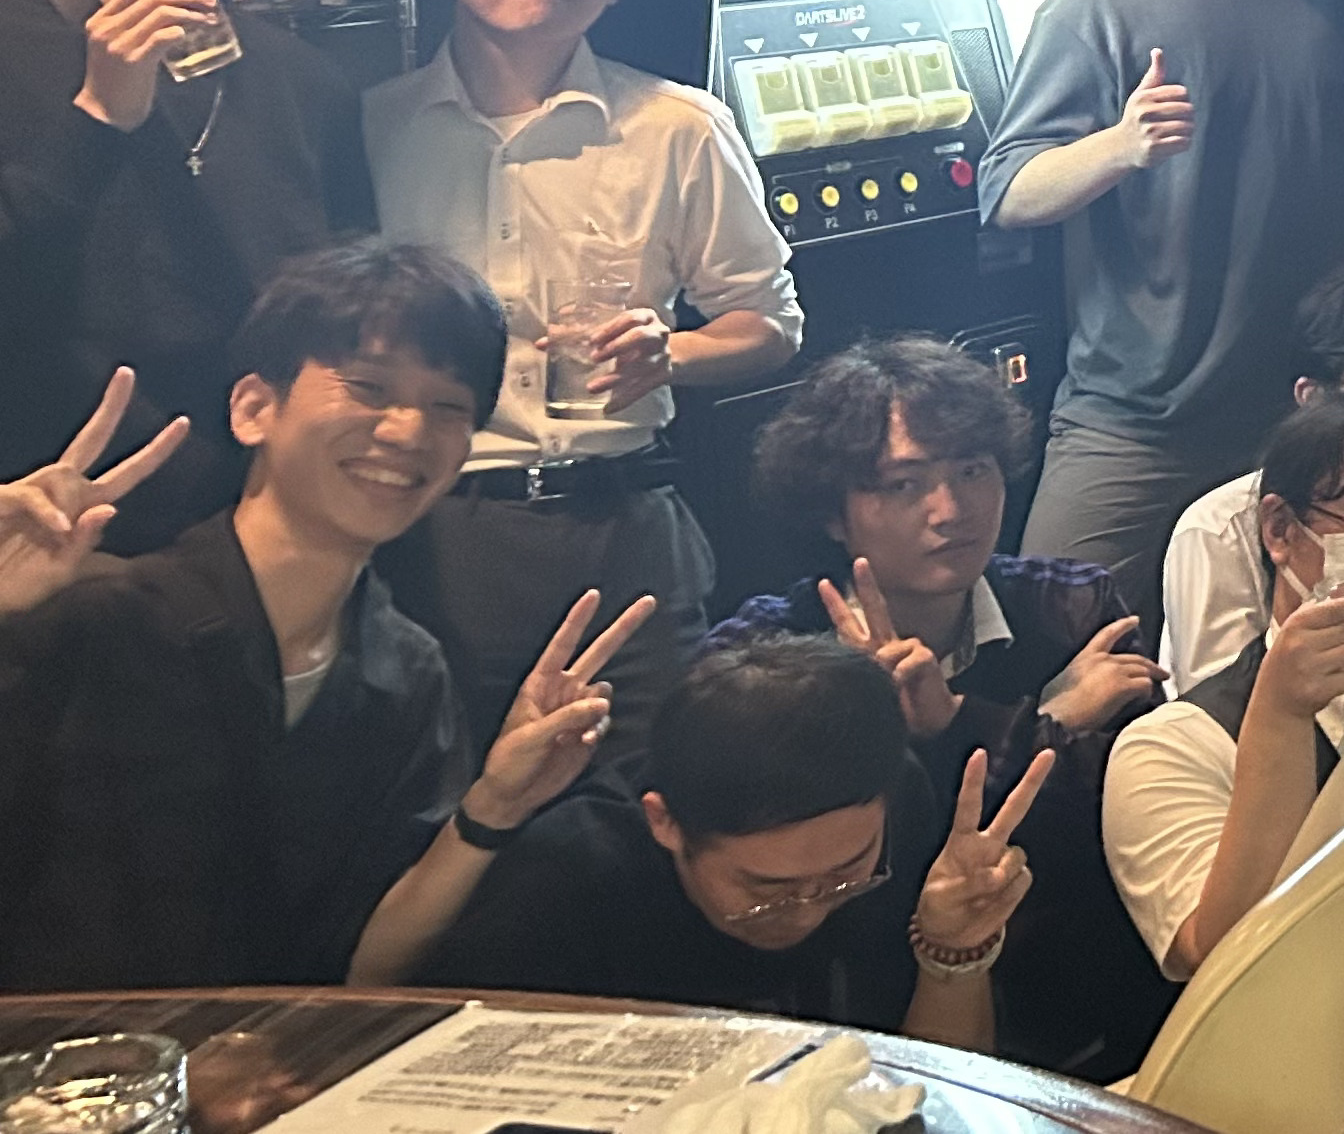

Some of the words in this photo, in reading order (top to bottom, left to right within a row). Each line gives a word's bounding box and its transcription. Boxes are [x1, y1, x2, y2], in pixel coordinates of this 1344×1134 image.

[865, 209, 878, 222] P3
[825, 217, 839, 228] P2
[784, 225, 796, 236] P1
